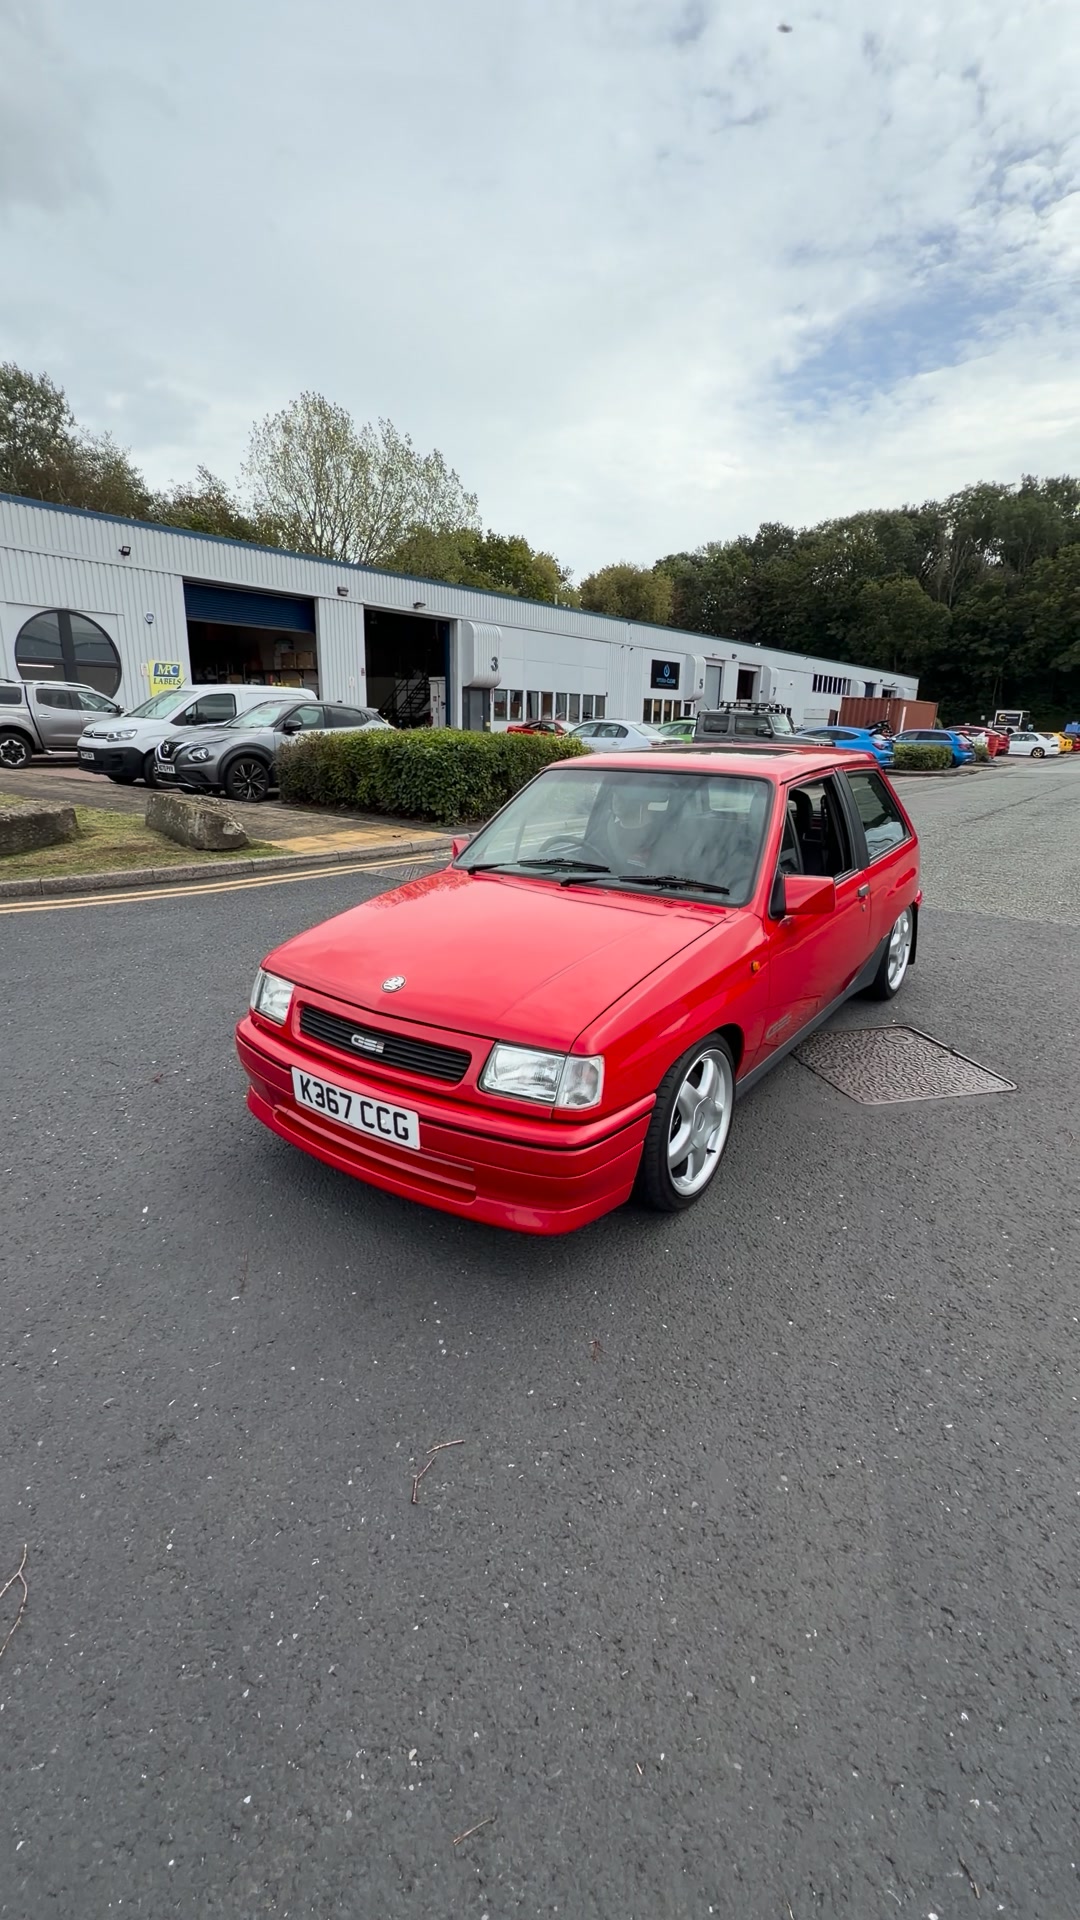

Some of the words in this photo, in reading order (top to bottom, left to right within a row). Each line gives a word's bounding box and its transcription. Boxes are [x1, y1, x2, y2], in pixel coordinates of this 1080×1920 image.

[157, 664, 179, 675] MPC
[491, 656, 499, 672] 3
[153, 677, 181, 686] LABELS
[698, 678, 704, 690] 5
[772, 686, 777, 696] 7
[300, 1075, 352, 1119] K367
[360, 1100, 409, 1141] CCG
